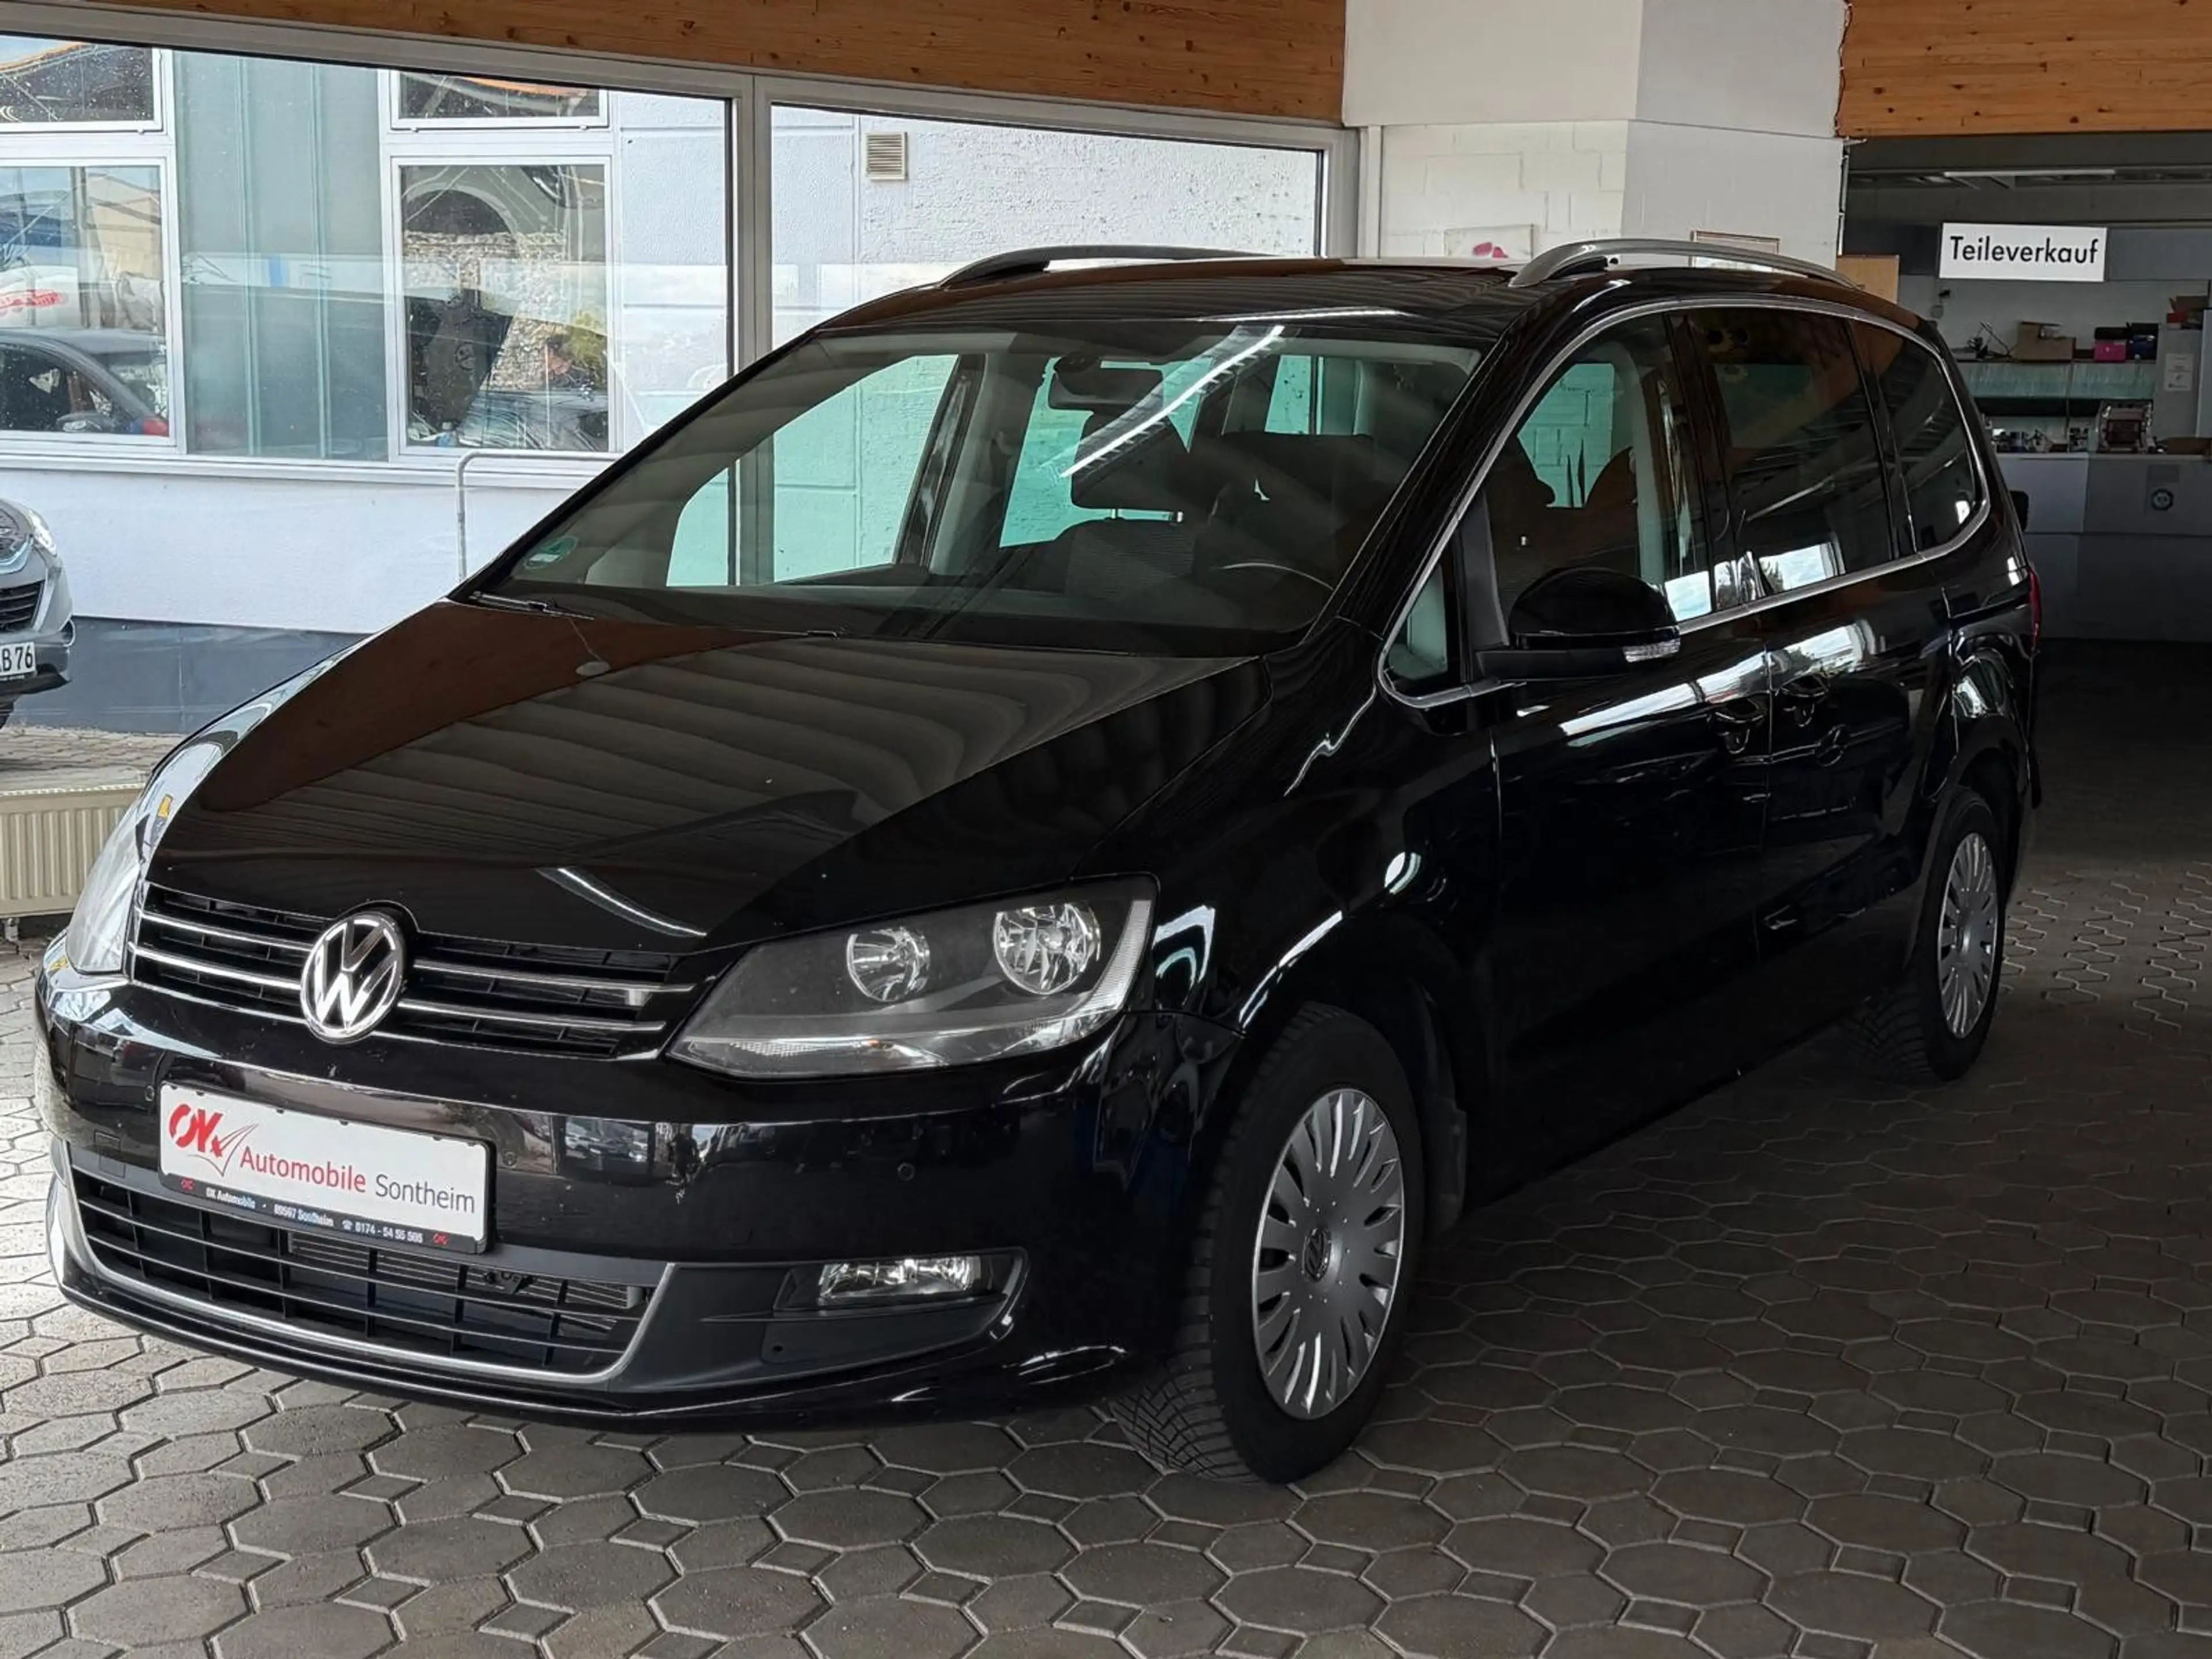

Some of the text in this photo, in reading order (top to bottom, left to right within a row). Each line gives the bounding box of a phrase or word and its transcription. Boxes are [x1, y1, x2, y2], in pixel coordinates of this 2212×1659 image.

[1950, 235, 2099, 264] Teileverkauf
[240, 1145, 475, 1214] Automobile Sontheim
